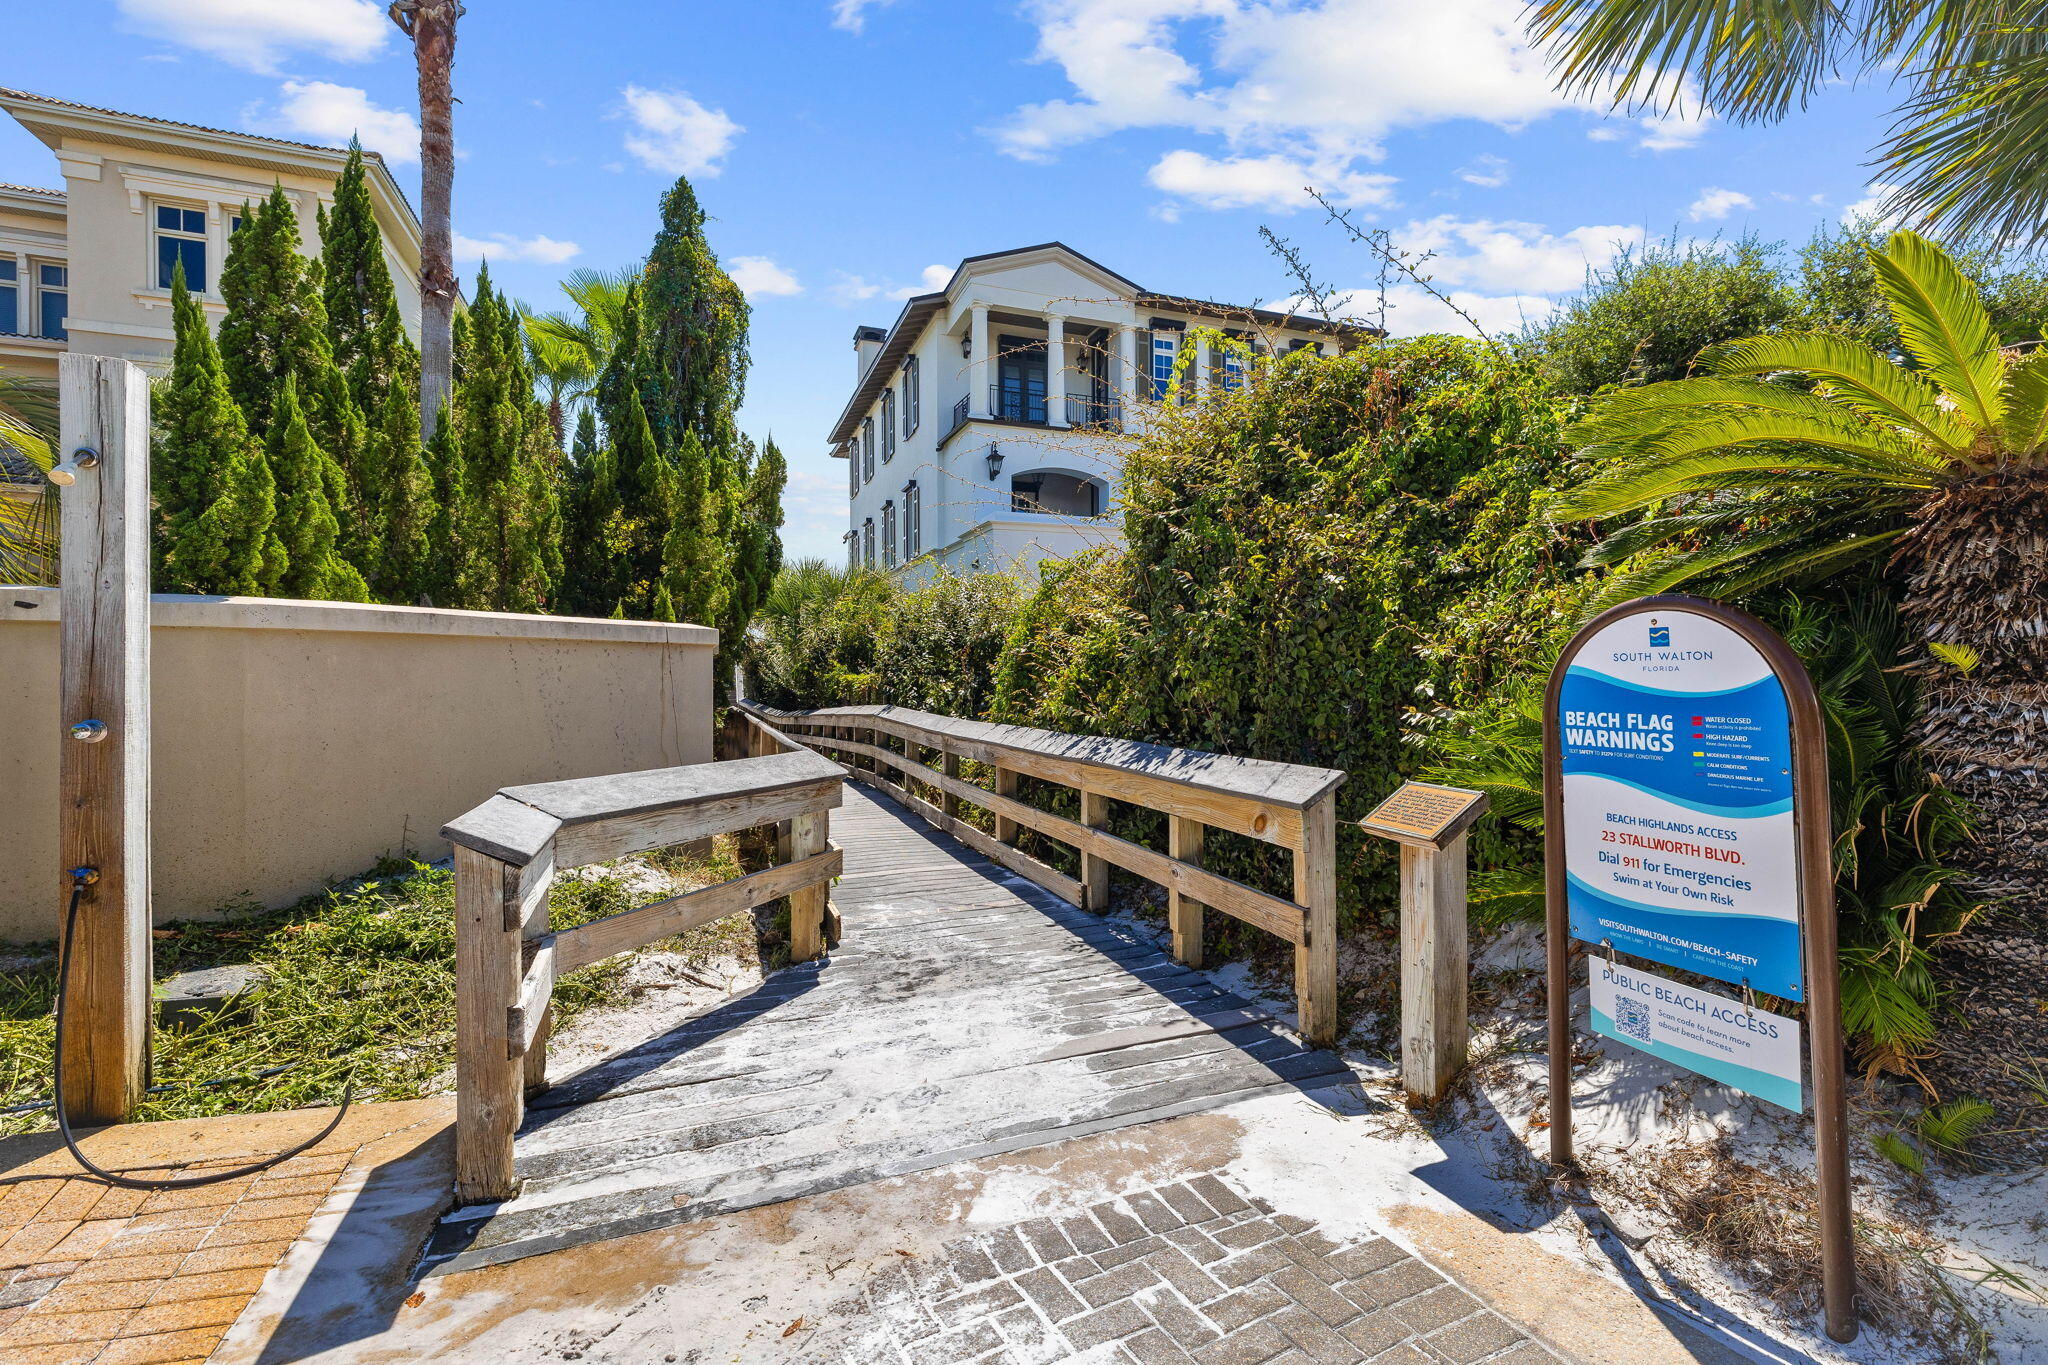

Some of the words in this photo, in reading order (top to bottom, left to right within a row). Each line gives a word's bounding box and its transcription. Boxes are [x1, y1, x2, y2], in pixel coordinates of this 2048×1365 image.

[1613, 652, 1652, 662] SOUTH
[1658, 651, 1713, 661] WALTON
[1565, 711, 1620, 728] BEACH
[1627, 713, 1673, 731] FLAG
[1565, 728, 1674, 752] WARNINGS
[1606, 813, 1636, 825] BEACH
[1638, 817, 1694, 835] HIGHLANDS
[1697, 826, 1738, 841] ACCESS
[1601, 830, 1616, 842] 23
[1620, 832, 1700, 857] STALLWORTH
[1705, 846, 1745, 865] BLVD.
[1599, 851, 1619, 865] Dial
[1623, 856, 1640, 869] 911
[1643, 859, 1660, 872] for
[1664, 863, 1752, 891] Emergencies
[1613, 872, 1640, 886] Swim
[1643, 879, 1652, 889] at
[1655, 881, 1679, 894] Your
[1682, 886, 1707, 900] Own
[1710, 892, 1734, 907] Risk
[1599, 918, 1758, 967] VISITSOUTHWALTON.COM/BEACH-SAFETY
[1664, 946, 1679, 954] SMART
[1693, 953, 1705, 962] CARE
[1706, 956, 1716, 964] FOR
[1717, 960, 1727, 968] THE
[1727, 963, 1744, 972] COAST
[1602, 970, 1650, 996] PUBLIC
[1655, 986, 1706, 1015] BEACH
[1711, 1007, 1779, 1039] ACCESS
[1658, 1009, 1675, 1022] Scan
[1676, 1016, 1696, 1029] code
[1697, 1022, 1705, 1031] to
[1707, 1026, 1728, 1040] learn
[1729, 1035, 1751, 1048] more
[1658, 1020, 1680, 1035] about
[1681, 1027, 1705, 1042] beach
[1706, 1039, 1734, 1054] access.
